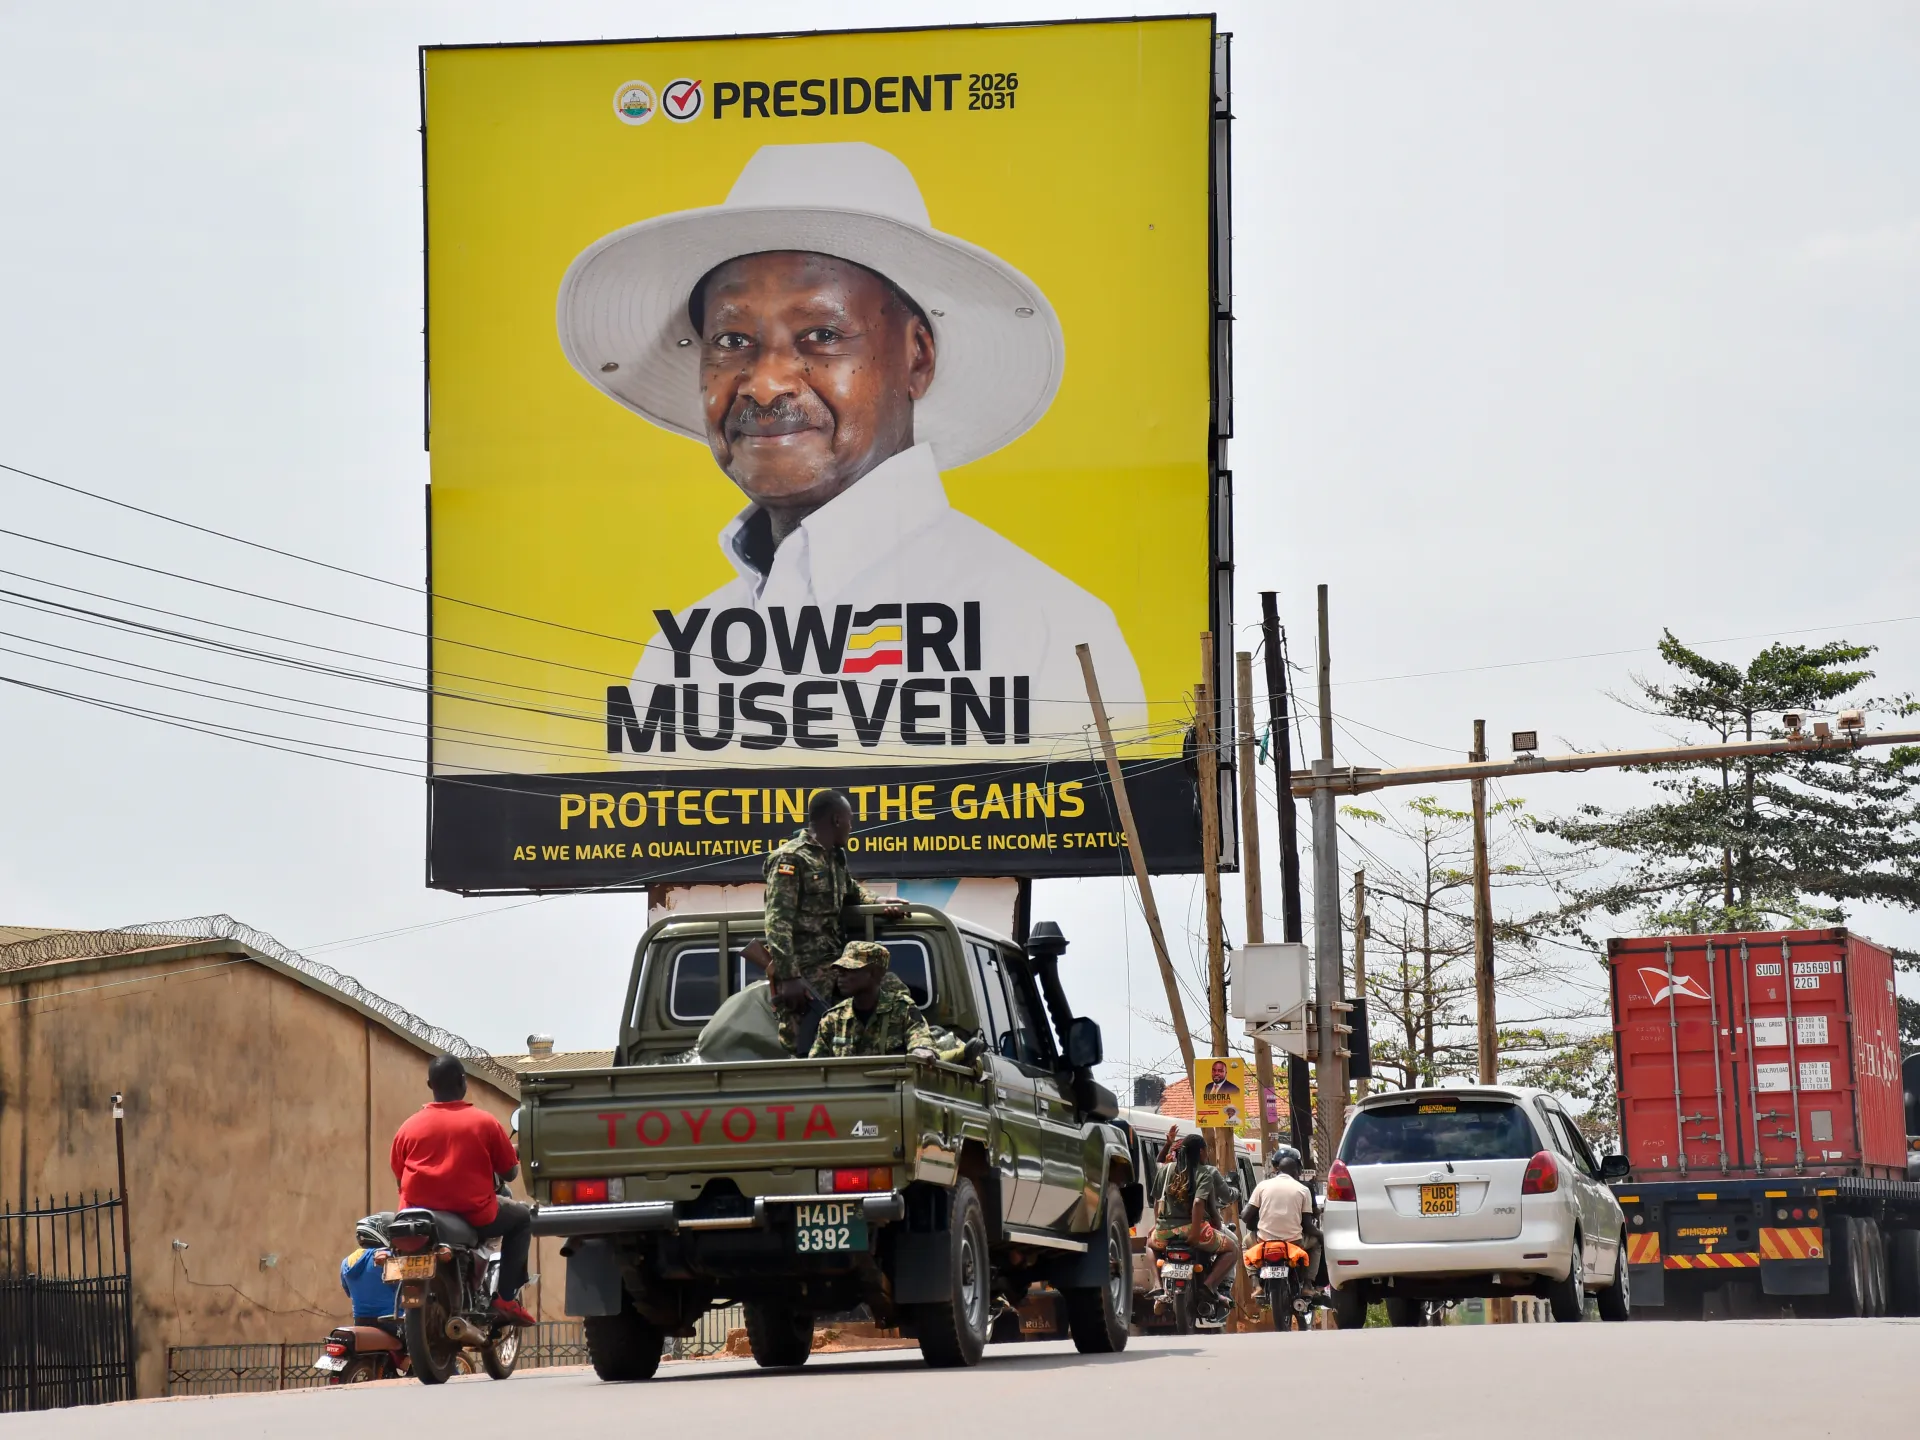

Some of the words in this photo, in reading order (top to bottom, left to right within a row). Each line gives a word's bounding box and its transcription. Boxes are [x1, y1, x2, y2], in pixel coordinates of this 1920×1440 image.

[968, 73, 1019, 92] 2026
[713, 73, 962, 120] PRESIDENT
[968, 91, 1015, 111] 2031
[652, 601, 981, 678] YOWERI
[606, 675, 1030, 754] MUSEVENI
[560, 788, 832, 830] PROTECTIN
[849, 784, 936, 822] THE
[951, 781, 1085, 820] GAINS
[513, 845, 537, 861] AS
[541, 845, 570, 861] WE
[575, 843, 626, 860] MAKE
[631, 843, 643, 858] A
[648, 839, 763, 858] QUALITATIVE
[865, 836, 908, 852] HIGH
[913, 834, 981, 852] MIDDLE
[988, 832, 1058, 850] INCOME
[1063, 831, 1129, 848] STATUS
[1756, 964, 1781, 976] SUDU
[1794, 961, 1830, 974] 735699
[1795, 977, 1818, 989] 22G1
[597, 1104, 838, 1148] TOYOTA
[1431, 1186, 1454, 1199] UBC
[796, 1203, 855, 1228] H4DF
[1424, 1201, 1453, 1213] 266D
[798, 1228, 850, 1251] 3392
